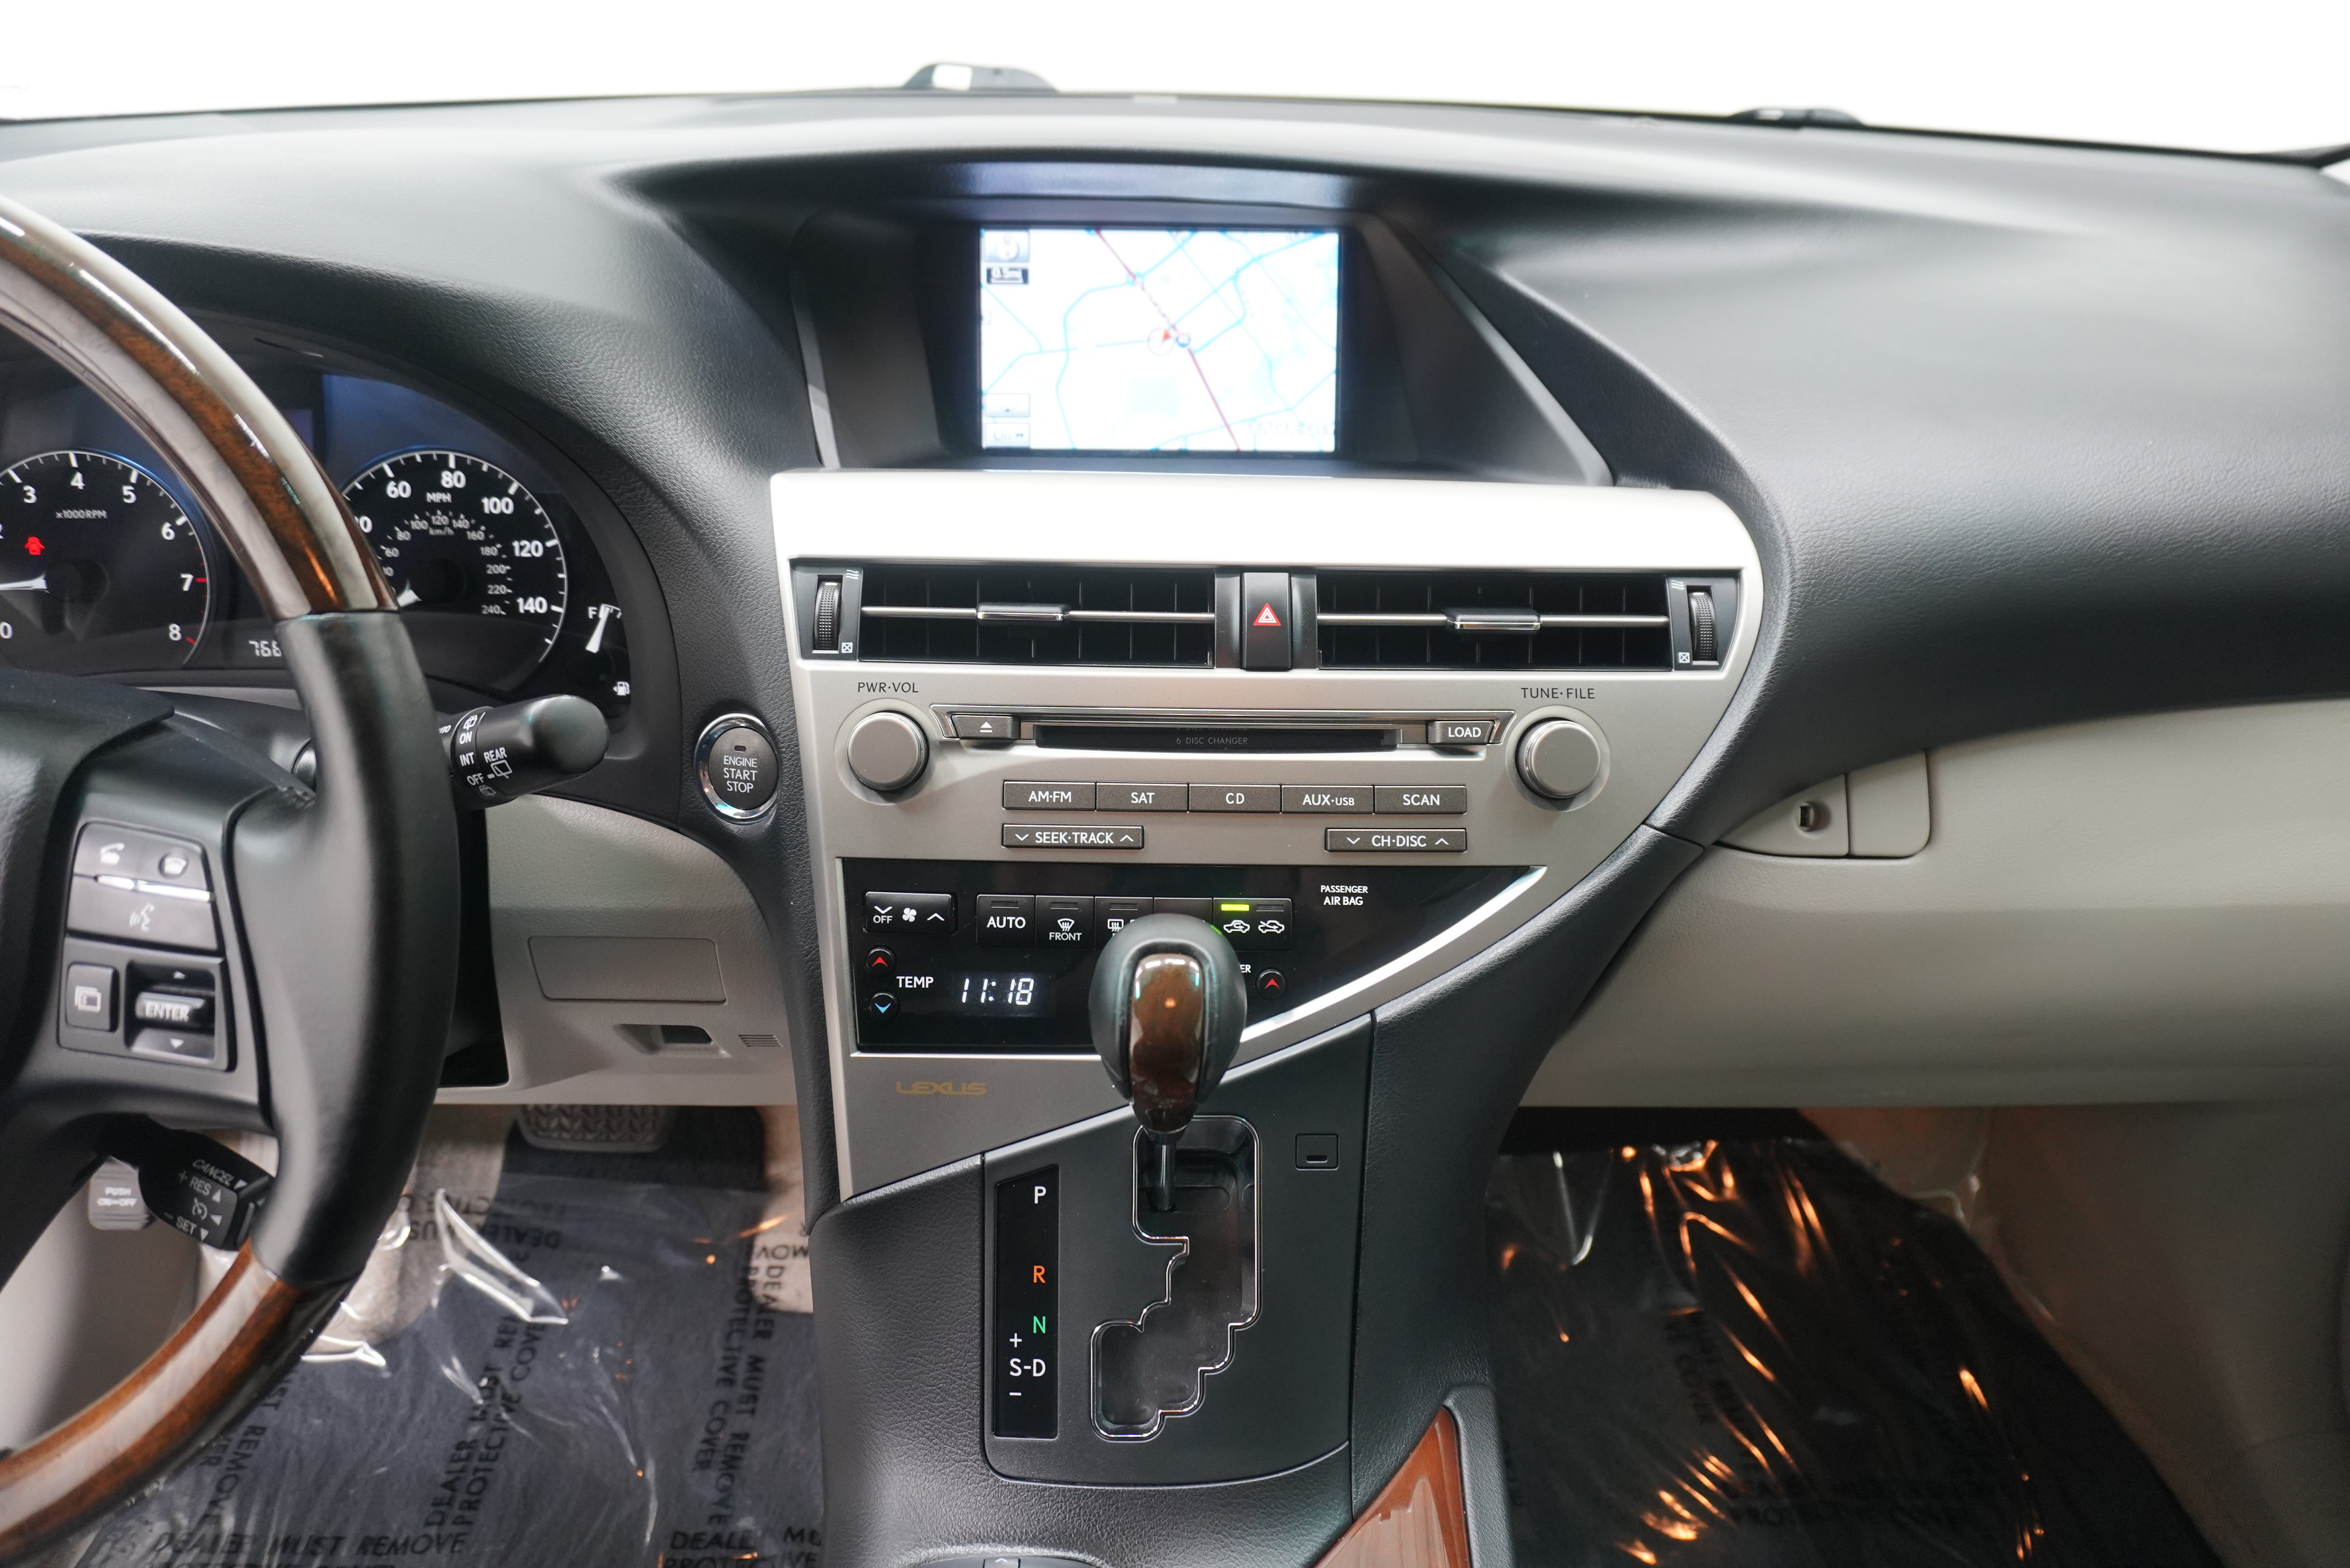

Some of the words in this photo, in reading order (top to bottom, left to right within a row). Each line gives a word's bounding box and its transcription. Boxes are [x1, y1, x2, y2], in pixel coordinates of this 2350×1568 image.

[70, 472, 85, 490] 4
[441, 471, 466, 488] 80
[23, 485, 37, 503] 3
[123, 486, 136, 503] 5
[387, 481, 412, 498] 60
[427, 492, 452, 503] MPH
[481, 497, 514, 514] 100
[355, 515, 372, 533] 0
[410, 518, 429, 530] 100
[432, 515, 449, 526] 120
[452, 518, 470, 530] 140
[161, 523, 175, 541] 6
[397, 530, 412, 541] 80
[429, 526, 455, 536] km/h
[466, 530, 486, 541] 160
[385, 547, 400, 558] 60
[480, 546, 499, 556] 180
[512, 540, 543, 558] 120
[486, 563, 507, 574] 200
[181, 573, 195, 592] 7
[487, 584, 508, 595] 220
[481, 604, 501, 615] 240
[517, 596, 548, 614] 140
[169, 624, 182, 641] 8
[459, 731, 473, 745] ON
[1447, 726, 1482, 739] LOAD
[459, 752, 475, 767] INT
[483, 747, 508, 764] REAR
[723, 755, 758, 768] ENGINE
[467, 773, 485, 786] OFF
[723, 767, 758, 781] START
[726, 780, 754, 794] STOP
[1130, 791, 1155, 804] SAT
[1225, 792, 1245, 805] CD
[1402, 793, 1441, 806] SCAN
[1320, 885, 1368, 894] PASSENGER
[1323, 895, 1341, 905] AIR
[1343, 895, 1364, 906] BAG
[873, 915, 893, 924] OFF
[986, 916, 1026, 929] AUTO
[1049, 931, 1082, 941] FRONT
[896, 976, 934, 988] TEMP
[961, 977, 1034, 1006] 11:18
[145, 1002, 191, 1023] ENTER
[895, 1081, 987, 1096] LEXUS
[189, 1176, 212, 1196] RES
[1034, 1185, 1047, 1204] P
[176, 1216, 197, 1235] SET
[1033, 1265, 1046, 1283] R
[754, 1266, 785, 1340] DEALER
[1033, 1316, 1046, 1334] N
[737, 1355, 766, 1417] MUST
[423, 1439, 479, 1527] DEALER
[356, 1532, 469, 1557] REMOVE
